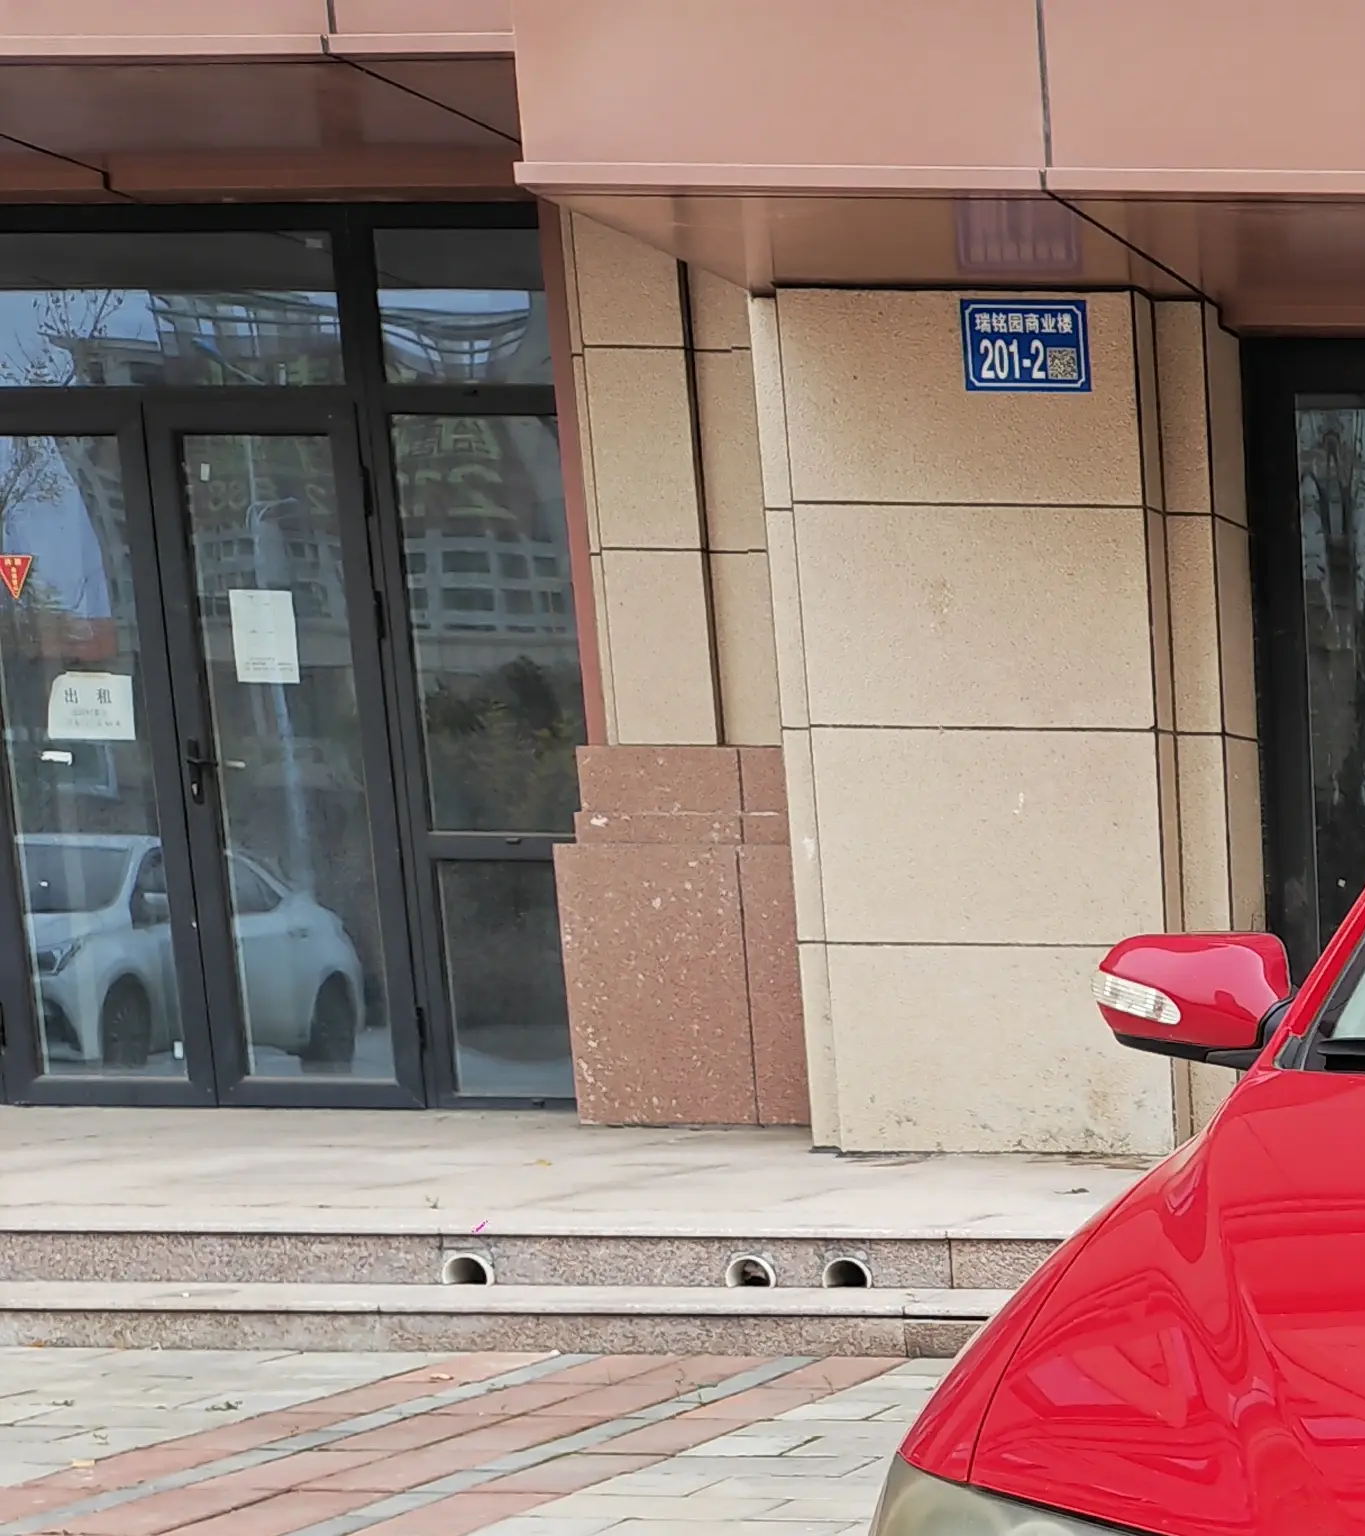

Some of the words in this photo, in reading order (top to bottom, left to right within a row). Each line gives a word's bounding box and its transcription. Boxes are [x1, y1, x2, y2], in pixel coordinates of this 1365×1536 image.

[974, 312, 1073, 334] 瑞铭园商业楼
[980, 338, 1046, 380] 201-2
[64, 688, 112, 704] 出租
